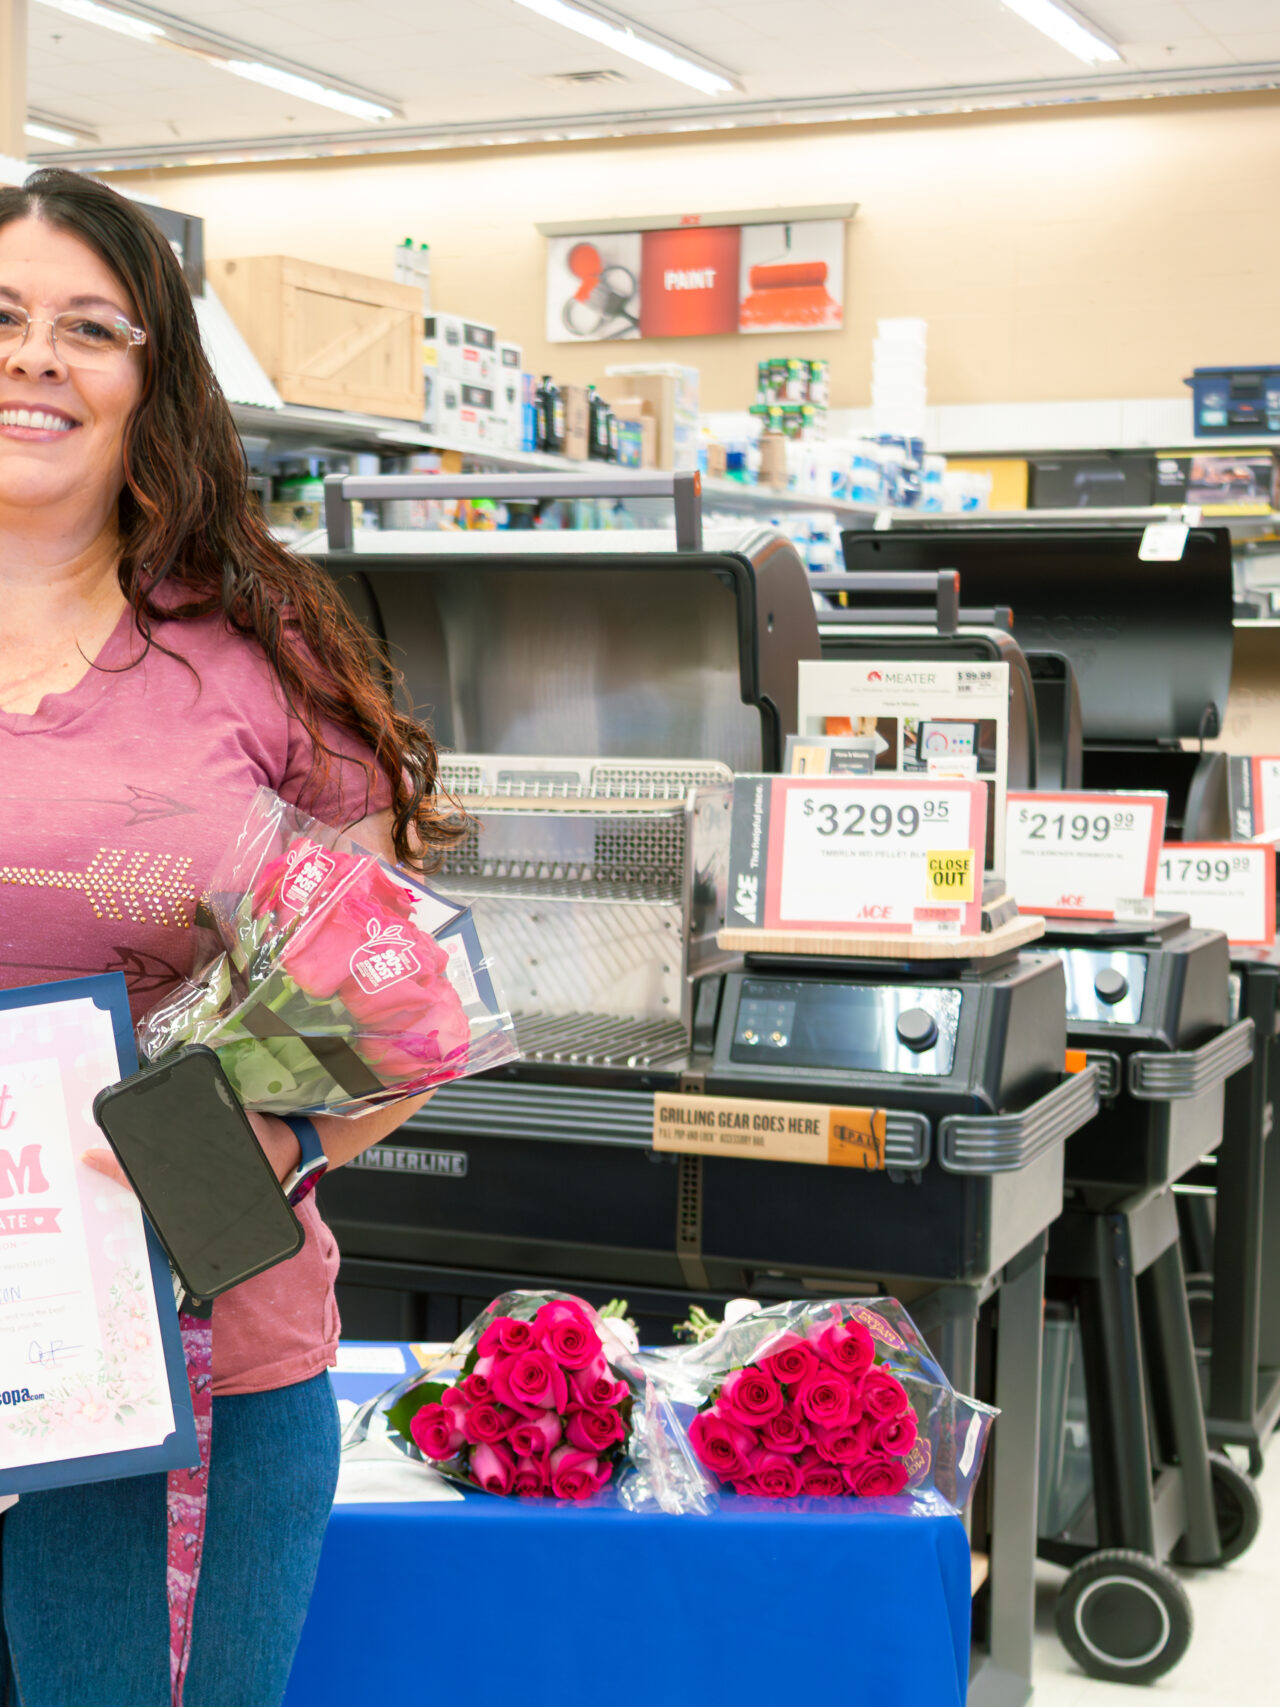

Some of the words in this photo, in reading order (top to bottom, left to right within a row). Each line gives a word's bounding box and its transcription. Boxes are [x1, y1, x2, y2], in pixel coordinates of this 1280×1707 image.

[664, 268, 716, 291] PAINT
[885, 673, 936, 684] MEATER
[923, 801, 949, 818] 95
[1114, 813, 1135, 827] 99
[929, 859, 970, 871] CLOSE
[1160, 859, 1230, 882] 1799
[294, 873, 319, 893] POST
[932, 872, 967, 887] OUT
[734, 873, 758, 924] ACE
[1057, 894, 1085, 907] ACE
[857, 905, 894, 919] ACE
[370, 953, 395, 980] POST
[660, 1107, 715, 1127] GRILLING
[718, 1111, 750, 1130] GEAR
[753, 1115, 785, 1132] GOES
[788, 1118, 820, 1136] HERE
[351, 1150, 465, 1174] IMBERLINE
